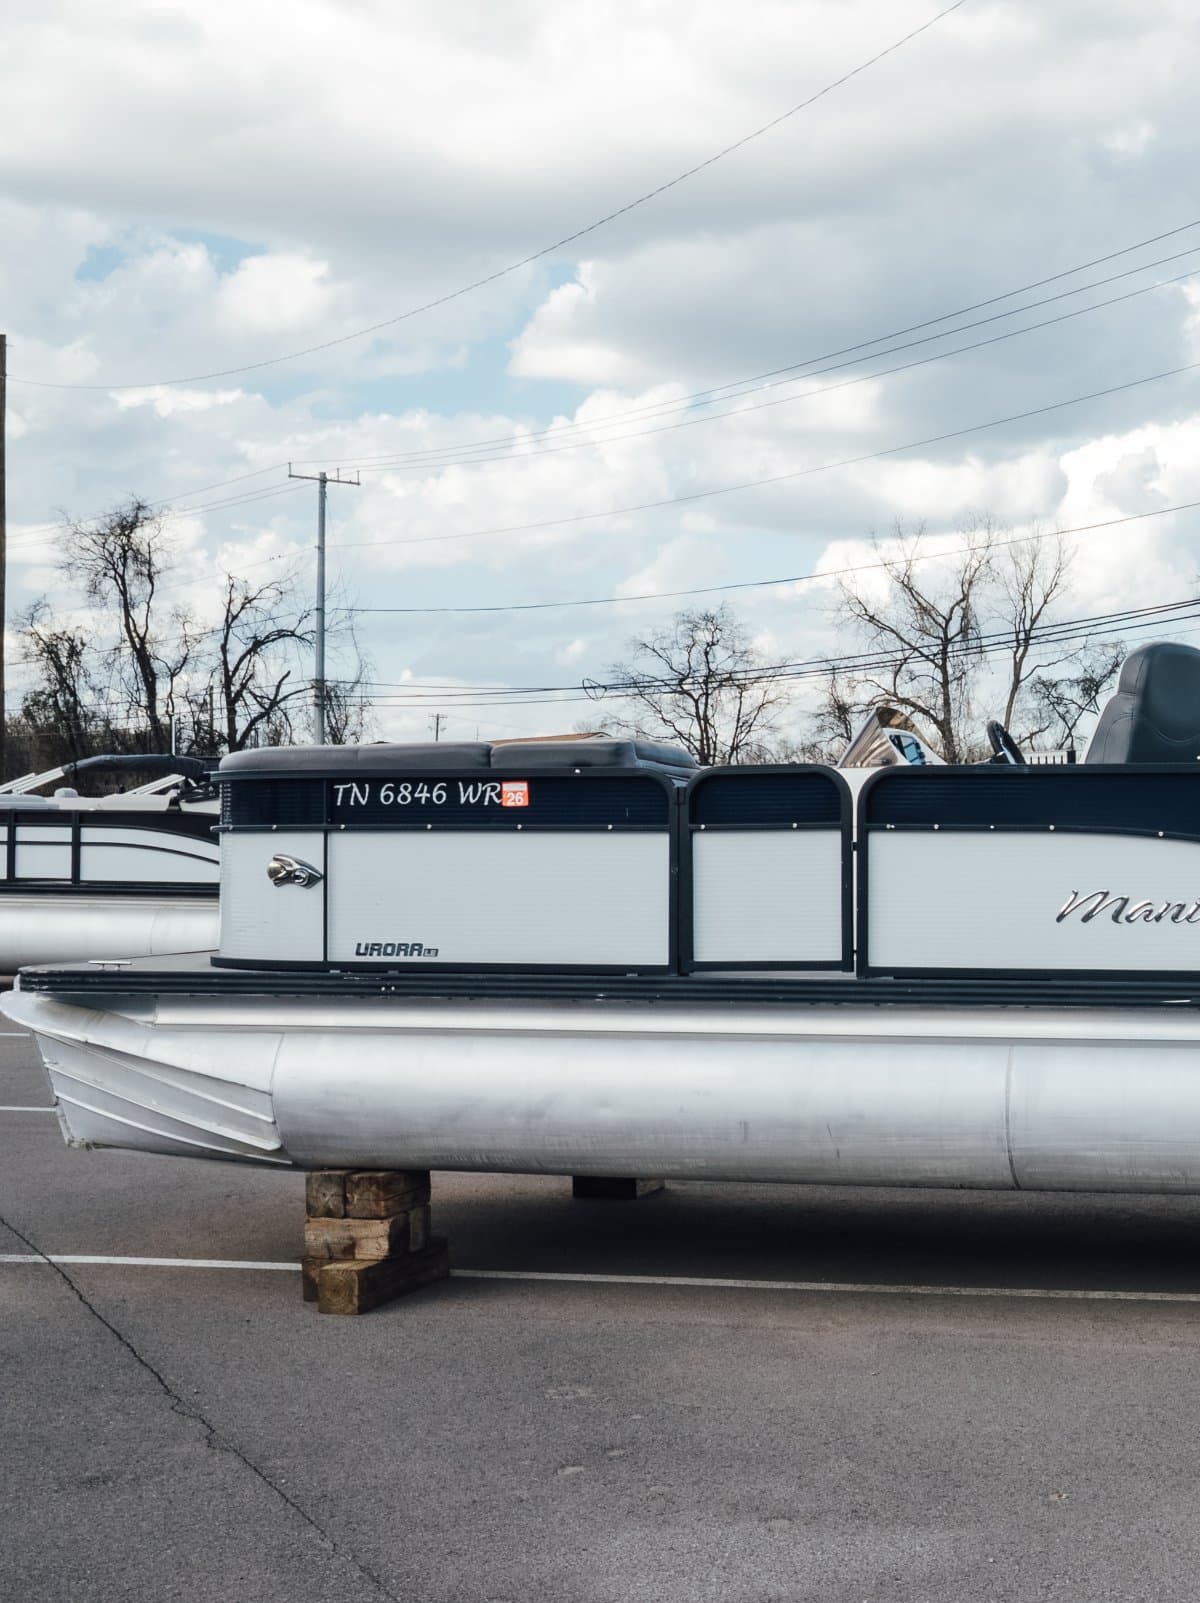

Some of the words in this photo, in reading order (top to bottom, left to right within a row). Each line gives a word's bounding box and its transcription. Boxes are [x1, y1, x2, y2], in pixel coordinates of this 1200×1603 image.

[333, 782, 369, 806] TN
[379, 782, 448, 805] 6846
[458, 782, 502, 806] WR
